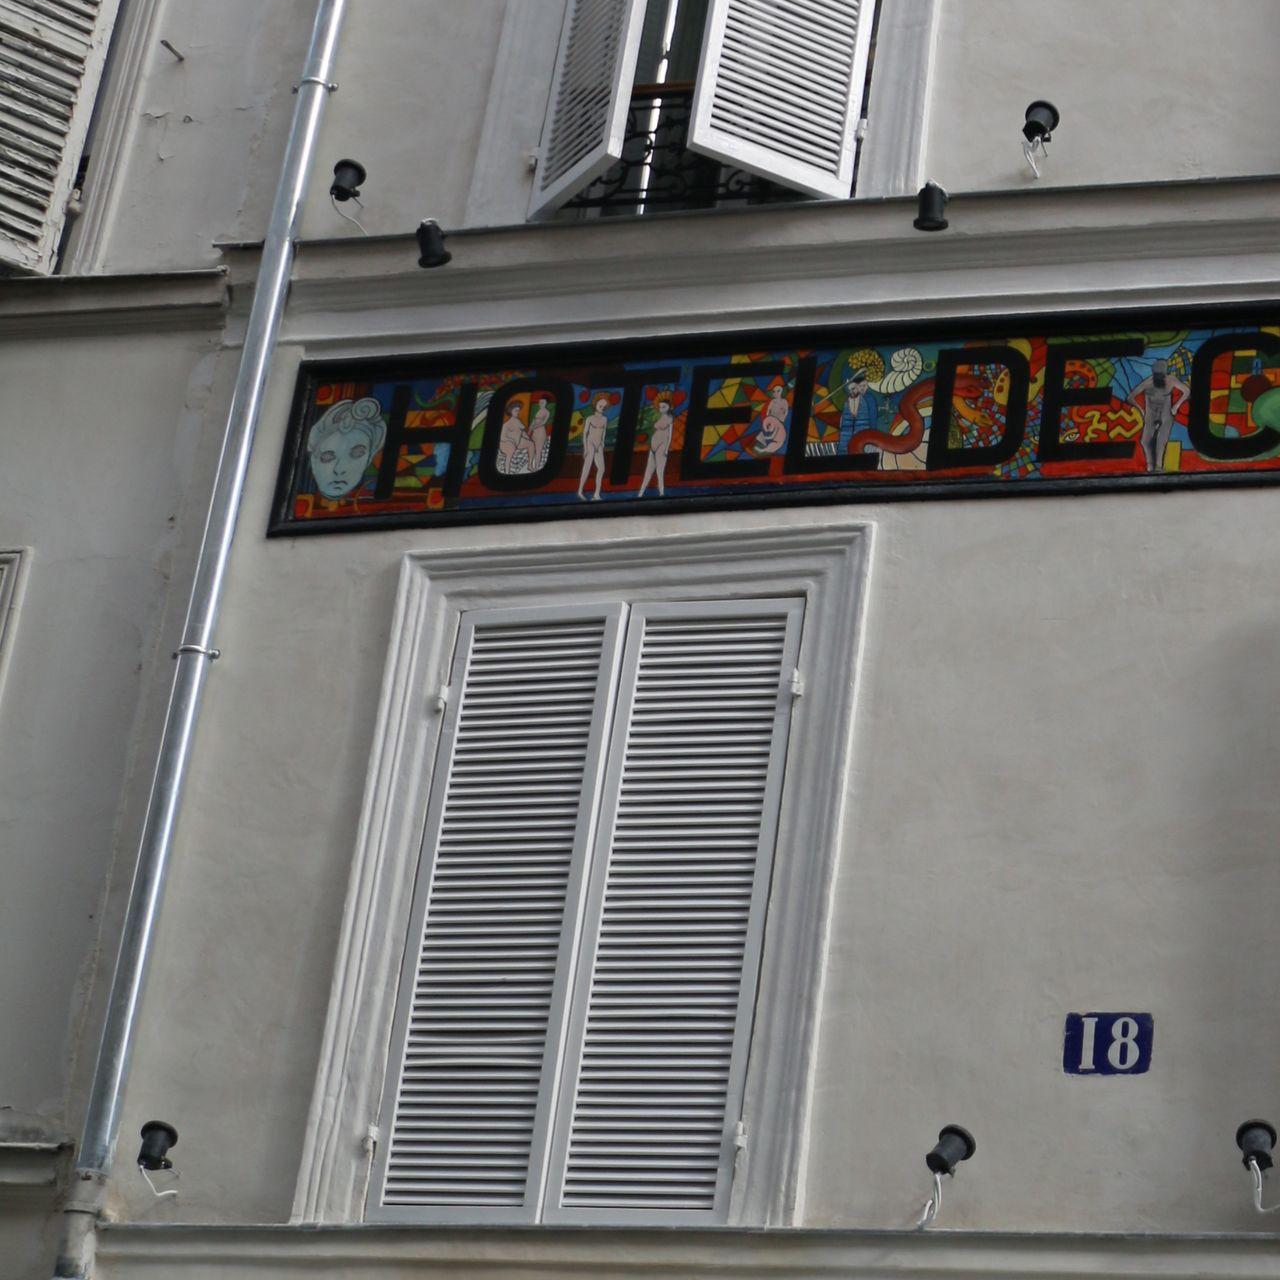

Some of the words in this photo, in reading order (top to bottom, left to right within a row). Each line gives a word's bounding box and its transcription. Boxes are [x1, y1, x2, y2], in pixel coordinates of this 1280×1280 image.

[375, 361, 880, 500] HOTEL
[929, 339, 1144, 468] DE
[1079, 1016, 1140, 1070] 18
